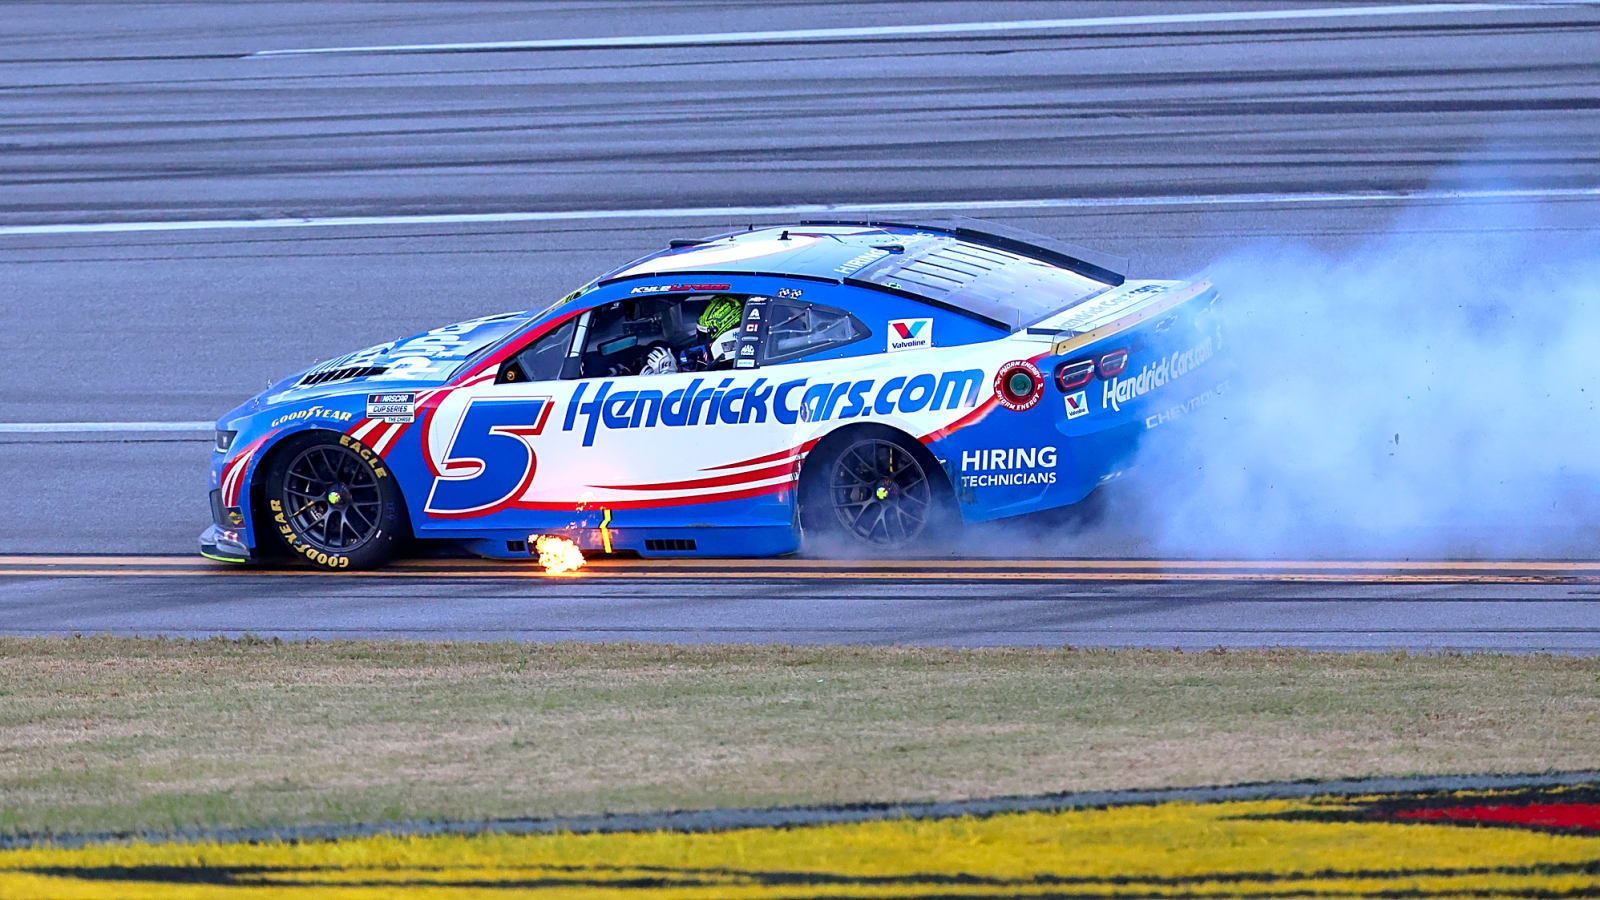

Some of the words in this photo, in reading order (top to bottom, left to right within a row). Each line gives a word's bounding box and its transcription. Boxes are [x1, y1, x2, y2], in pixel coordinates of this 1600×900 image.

[892, 340, 926, 349] Valvoline
[271, 406, 353, 428] GOODYEAR
[373, 405, 386, 413] CUP
[562, 368, 985, 447] HendrickCars.com
[339, 434, 387, 479] EAGLE
[424, 396, 555, 519] 5
[961, 446, 1057, 472] HIRING
[961, 472, 1057, 487] TECHNICIANS
[270, 500, 350, 568] GOODYEAR
